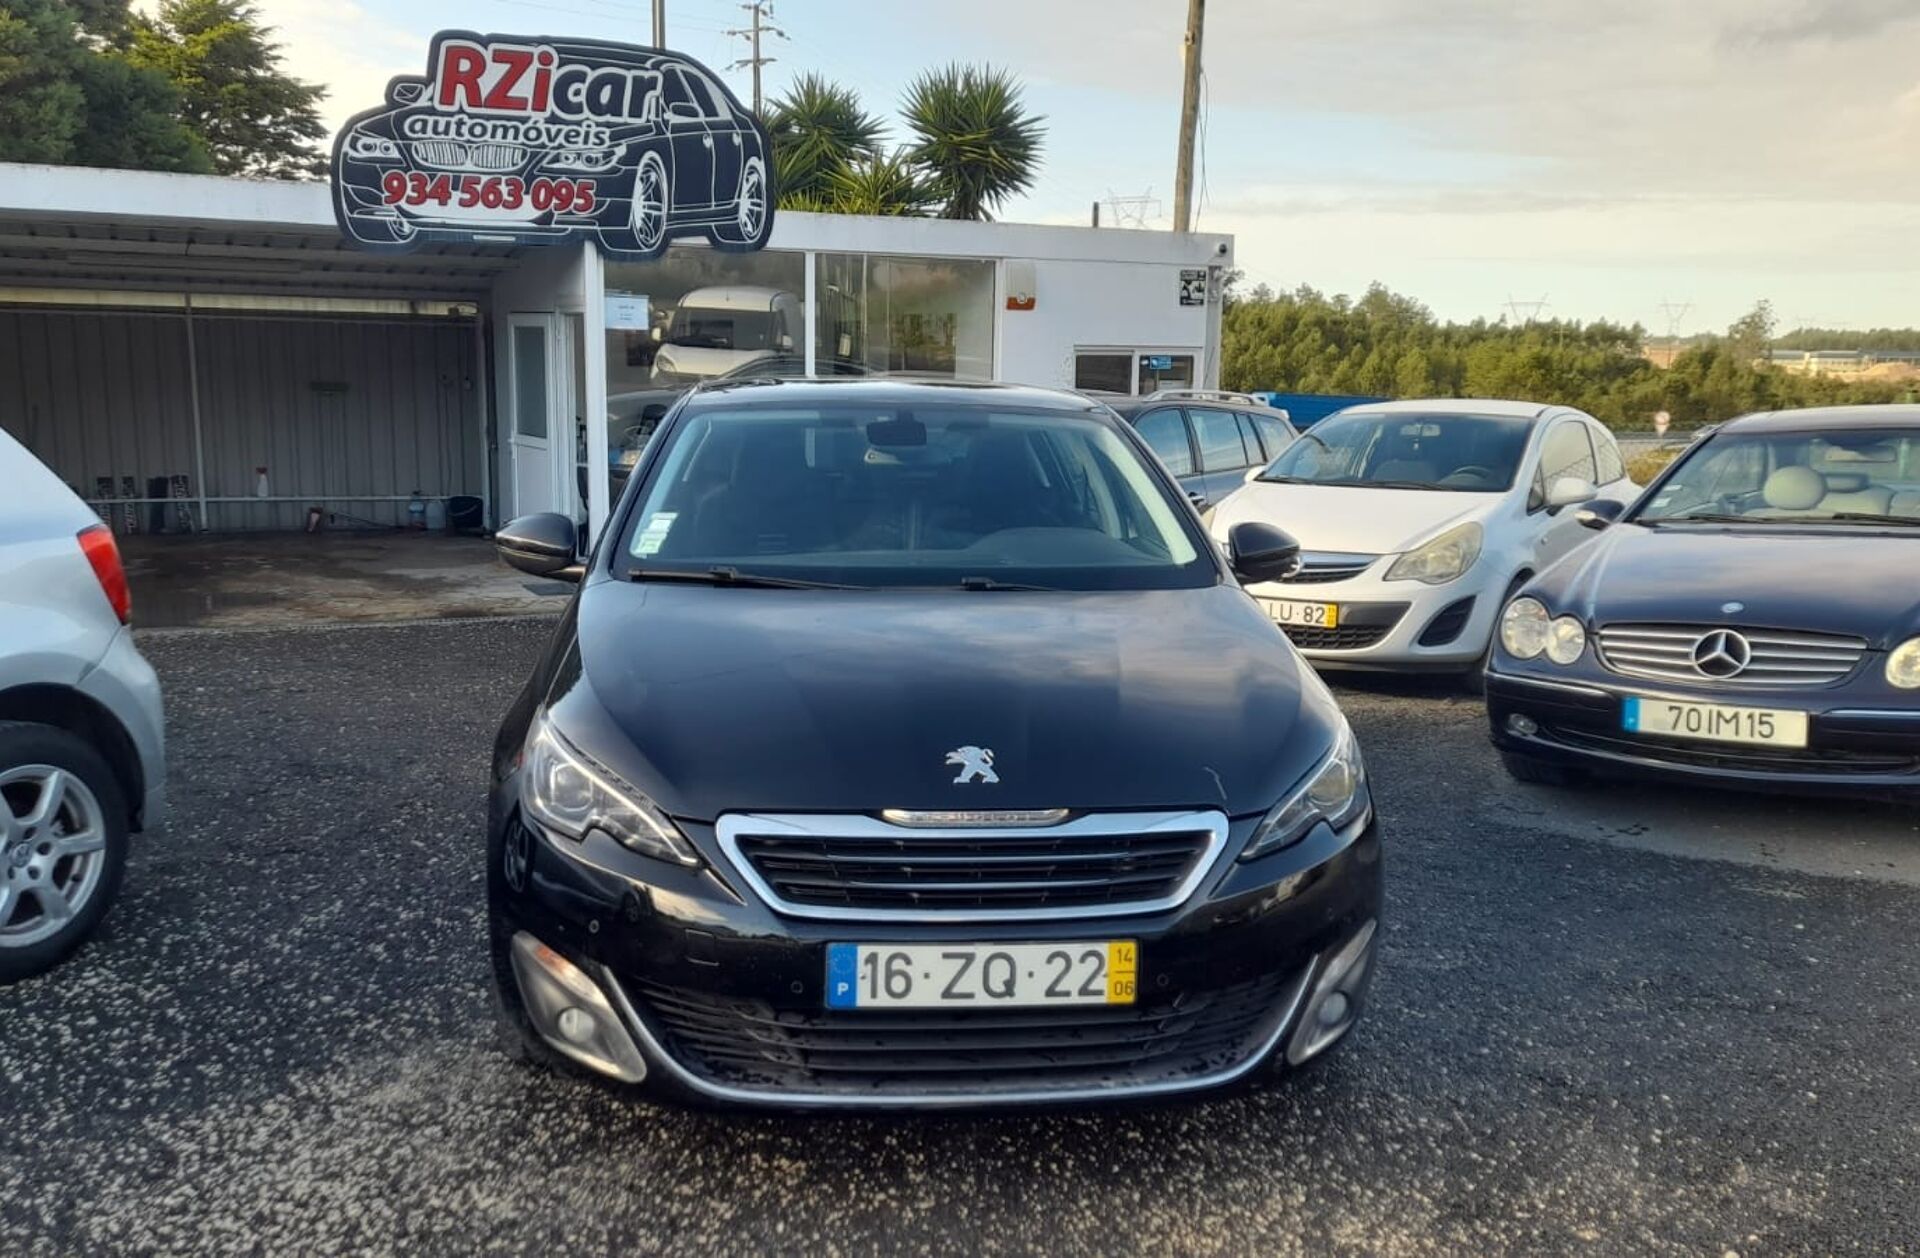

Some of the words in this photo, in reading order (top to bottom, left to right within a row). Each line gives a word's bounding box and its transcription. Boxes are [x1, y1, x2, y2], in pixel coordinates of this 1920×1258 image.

[406, 116, 609, 147] automóveis
[383, 171, 451, 206] 934
[458, 174, 524, 209] 563
[531, 177, 595, 212] 095
[1116, 948, 1133, 964] 14
[837, 982, 849, 995] P
[1114, 980, 1135, 996] 06
